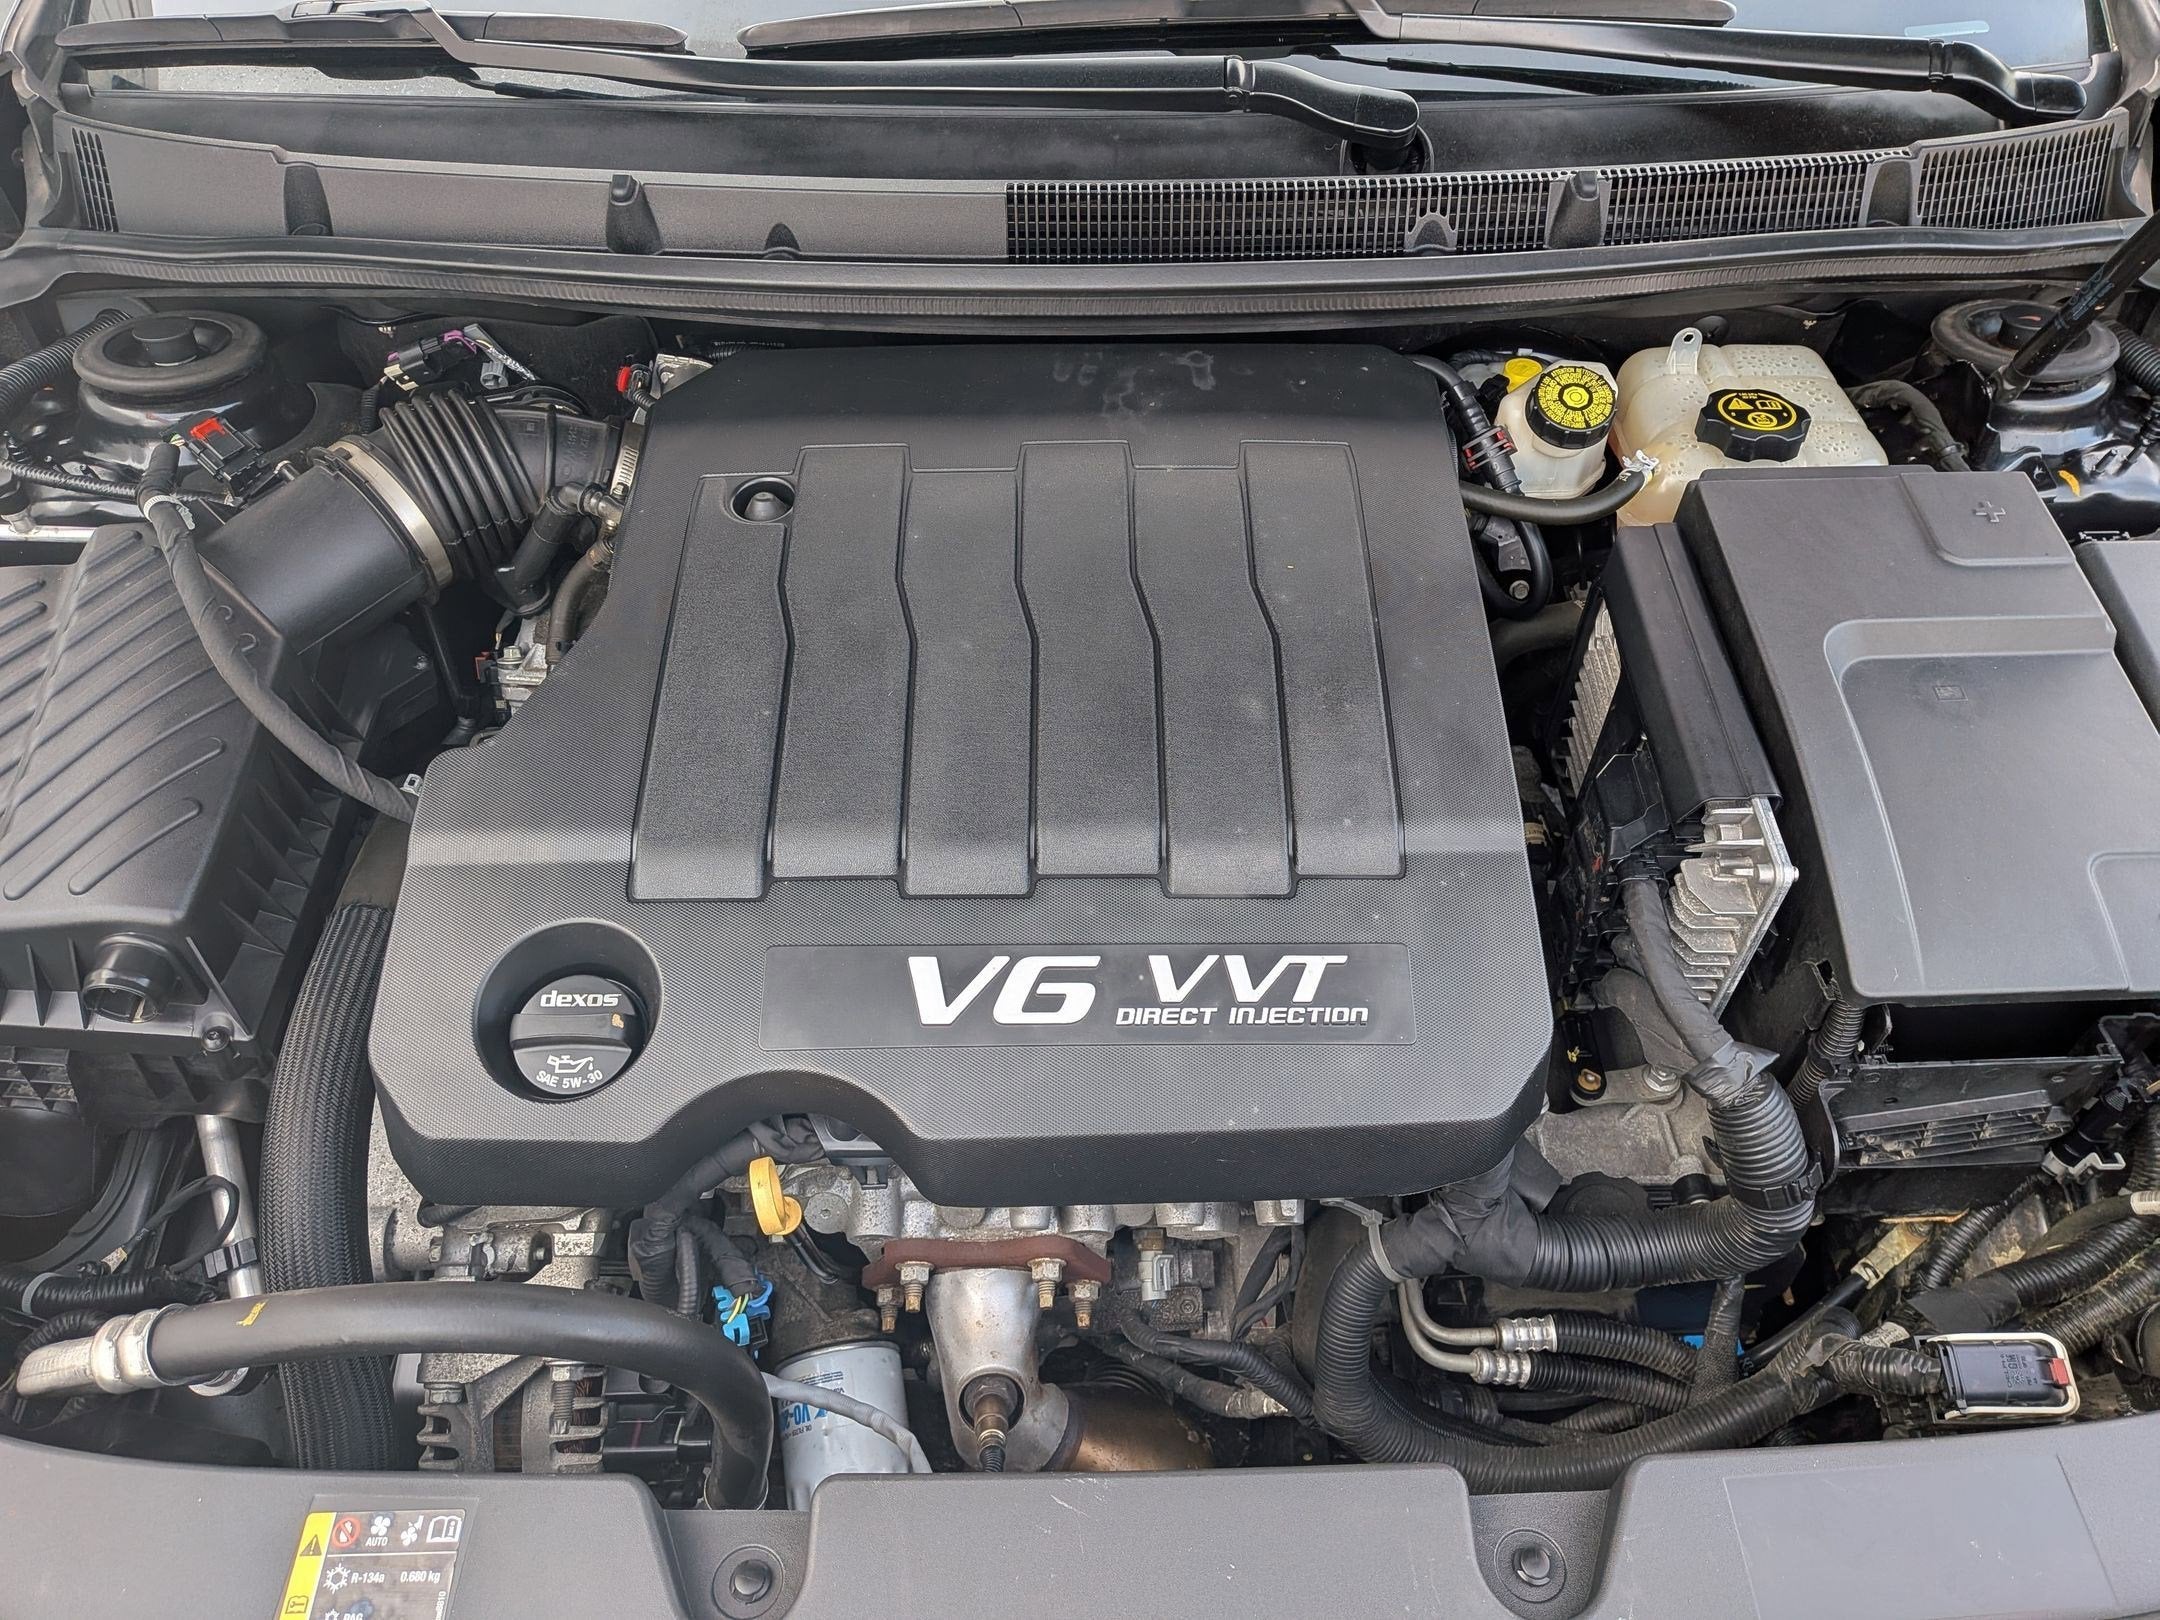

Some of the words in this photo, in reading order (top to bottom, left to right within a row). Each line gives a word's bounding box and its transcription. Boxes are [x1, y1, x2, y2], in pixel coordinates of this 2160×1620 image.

[540, 990, 620, 1008] dexos
[907, 955, 1101, 1026] V6
[1147, 954, 1349, 1004] VVT
[1115, 1006, 1219, 1026] DIRECT
[1227, 1006, 1369, 1026] INJECTION
[536, 1070, 559, 1088] SAE
[562, 1069, 603, 1089] 5W-30
[365, 1536, 388, 1547] AUTO
[350, 1571, 385, 1584] R-134a
[427, 1570, 441, 1584] kg
